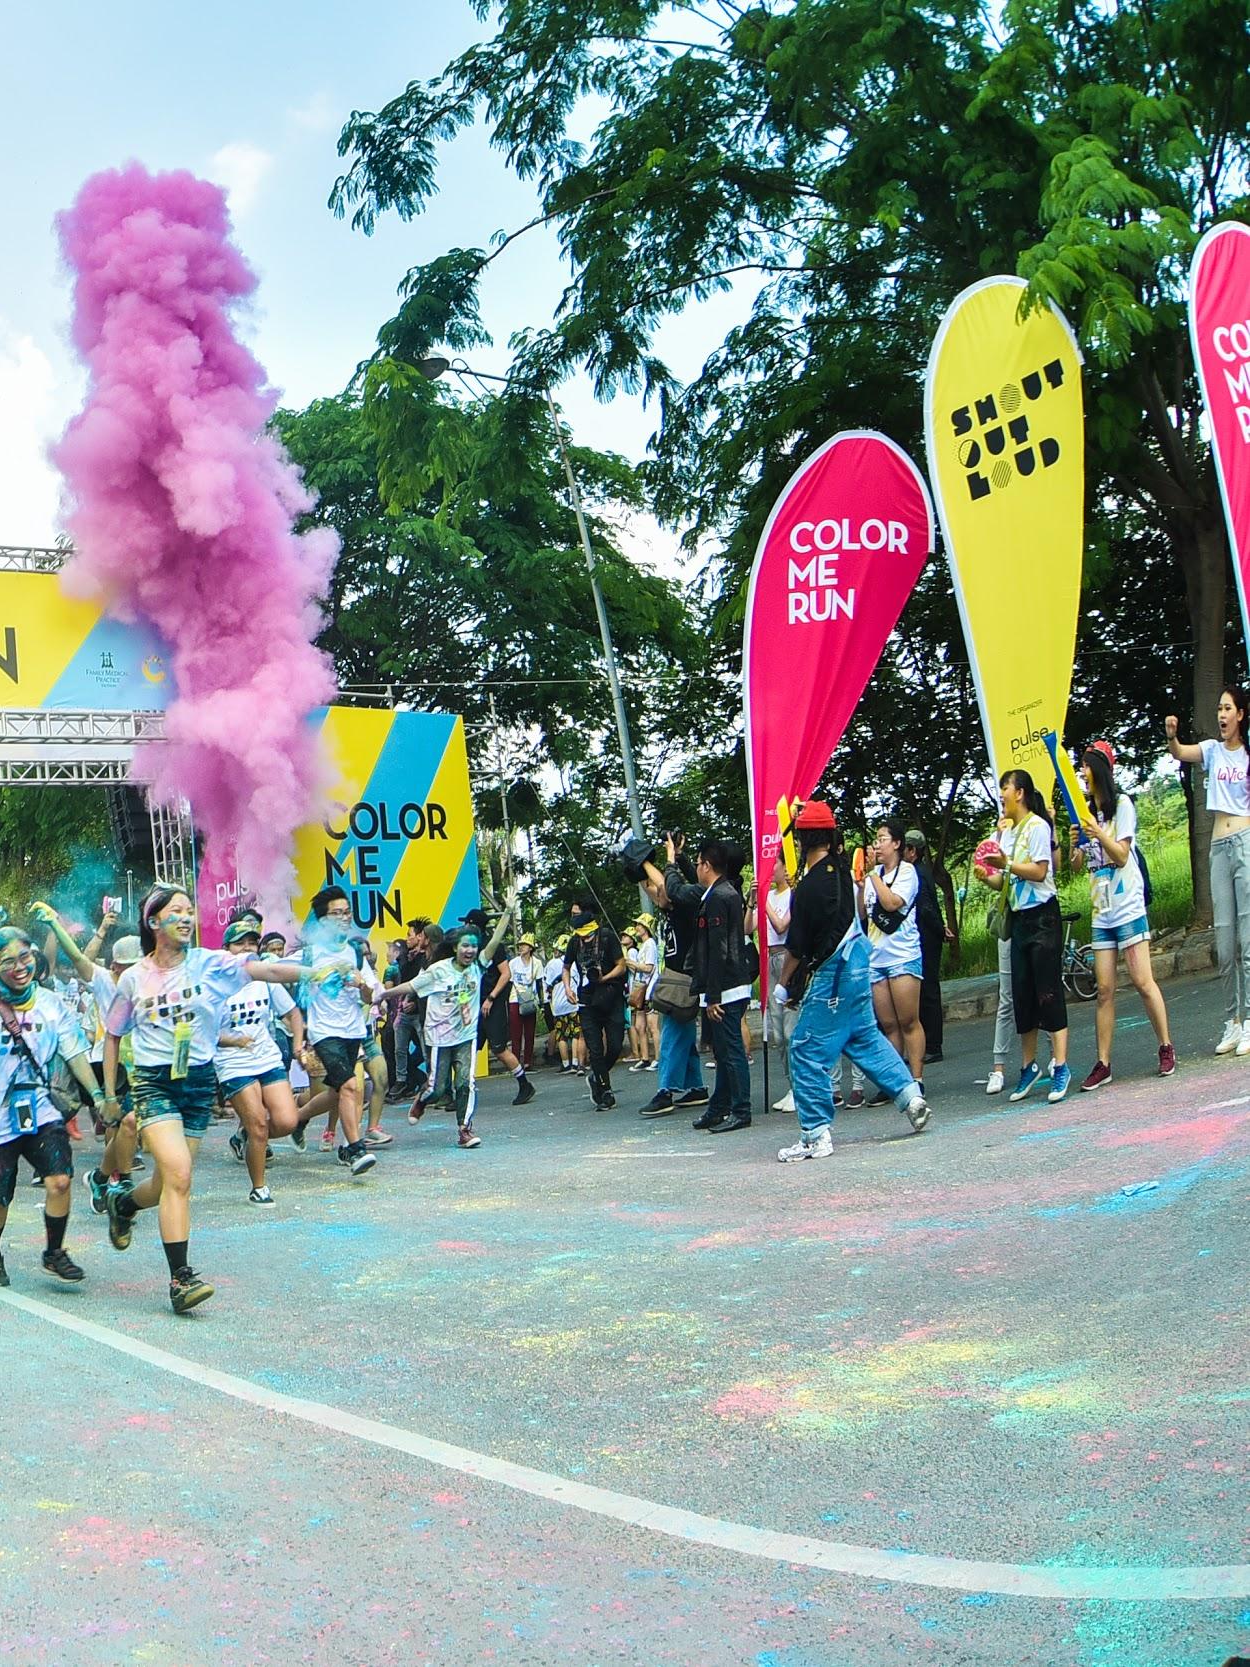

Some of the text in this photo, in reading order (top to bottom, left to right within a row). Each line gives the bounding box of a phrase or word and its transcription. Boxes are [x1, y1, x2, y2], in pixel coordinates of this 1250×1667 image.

[951, 358, 1065, 438] SHOUT
[956, 414, 1030, 469] OUT
[966, 437, 1060, 501] LOUD
[789, 518, 909, 554] COLOR
[788, 553, 840, 589] ME
[788, 588, 856, 625] RUN
[1011, 714, 1049, 754] pulse
[323, 801, 448, 840] COLOR
[324, 846, 381, 886] ME
[216, 866, 250, 907] puls
[351, 889, 403, 930] UN
